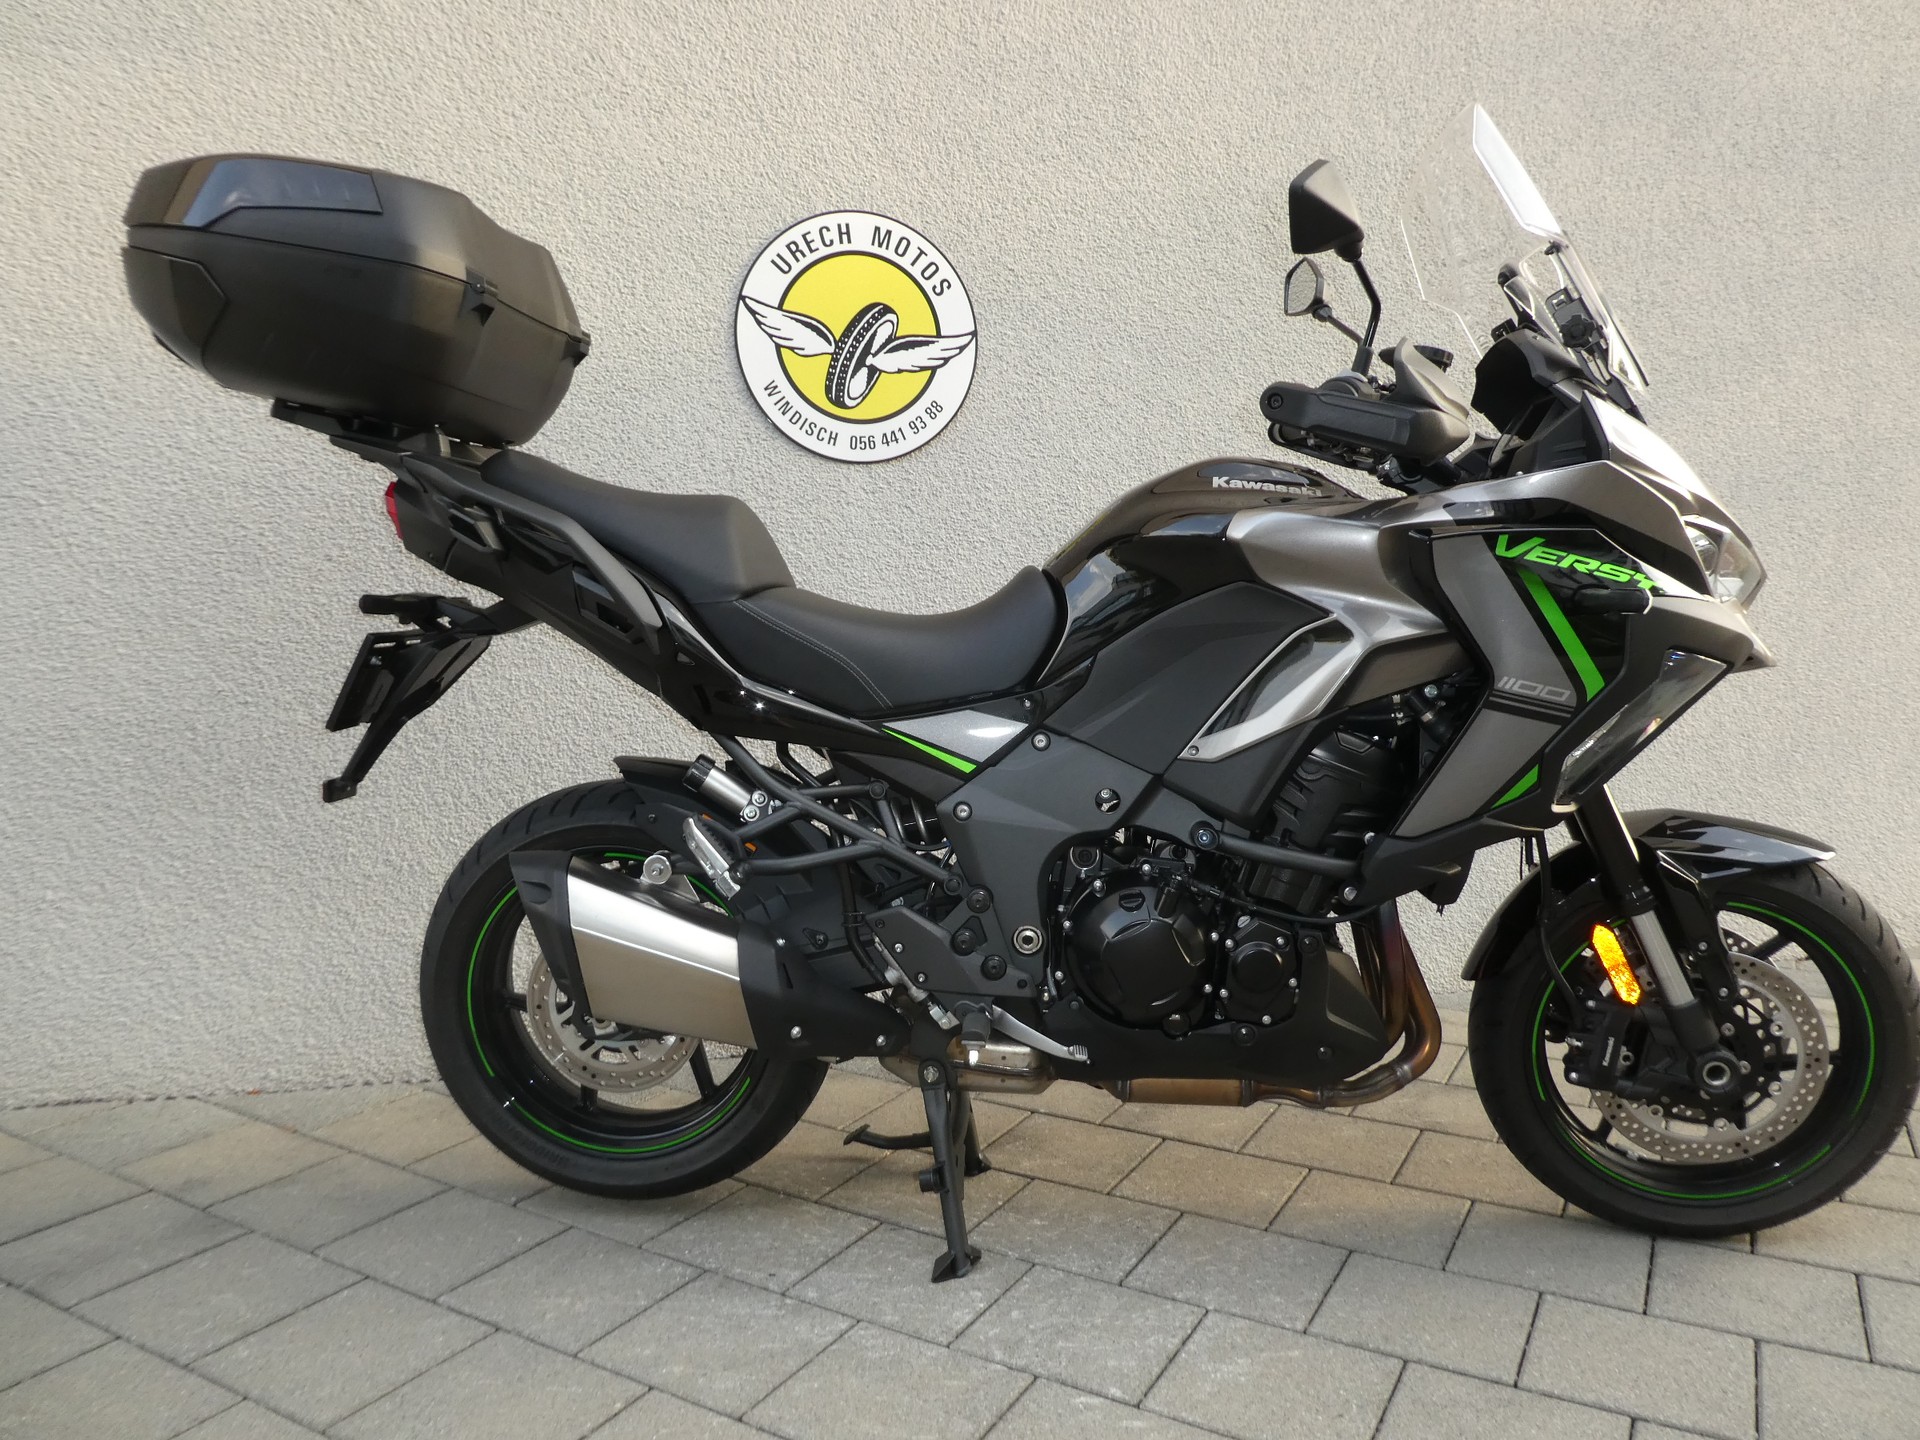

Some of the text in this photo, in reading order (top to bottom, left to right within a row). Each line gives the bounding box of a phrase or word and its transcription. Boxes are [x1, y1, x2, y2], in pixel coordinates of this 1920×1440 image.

[770, 223, 952, 297] URECH MOTOS
[763, 380, 944, 450] WINDISCH 056 441 93 88
[1212, 476, 1322, 497] Kawasaki
[1495, 534, 1666, 594] VERSY
[1497, 676, 1571, 701] 1100
